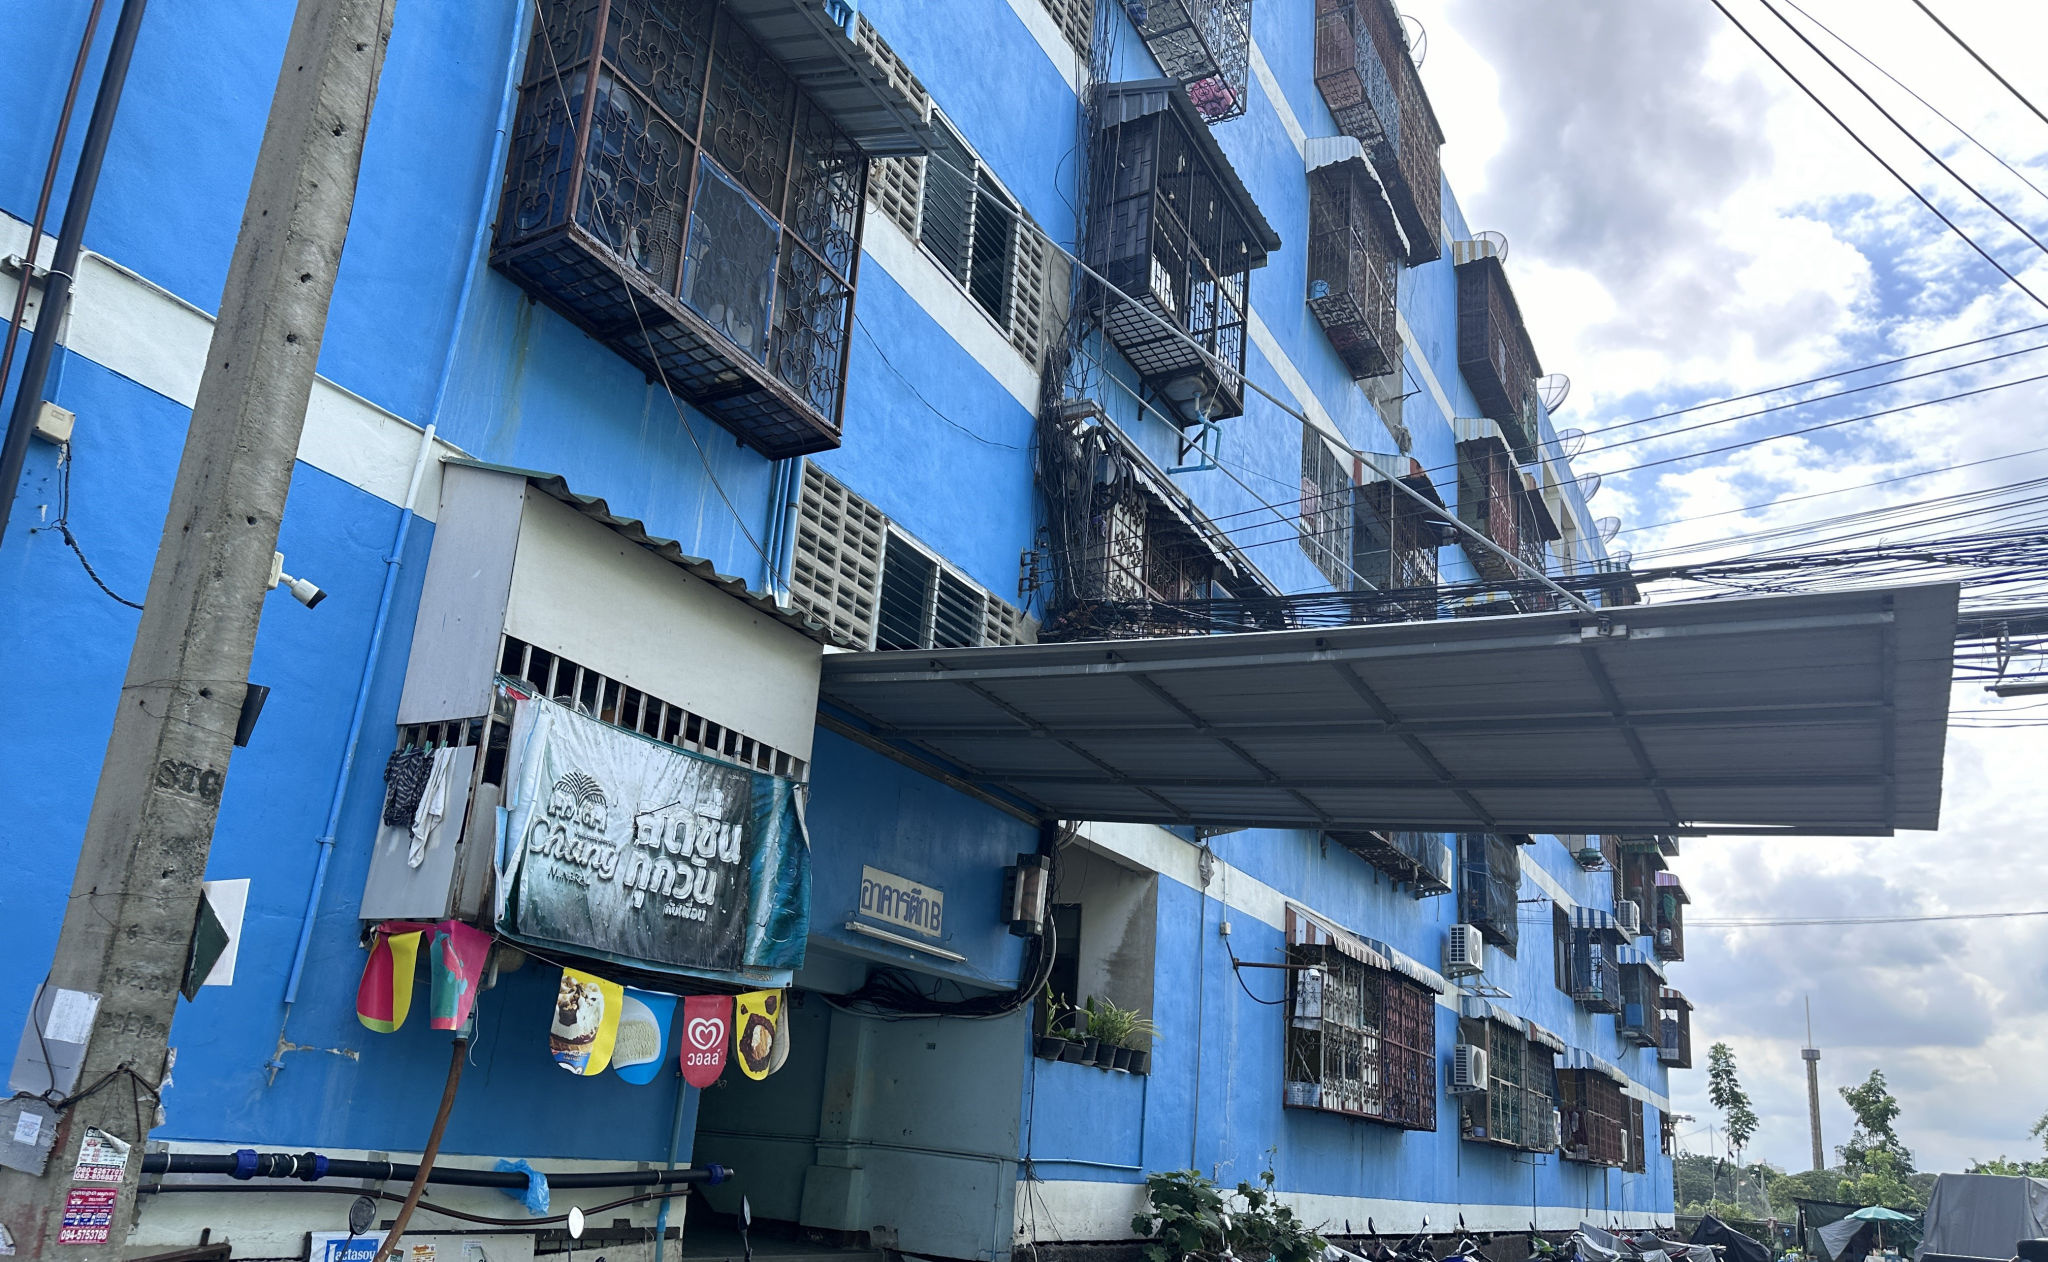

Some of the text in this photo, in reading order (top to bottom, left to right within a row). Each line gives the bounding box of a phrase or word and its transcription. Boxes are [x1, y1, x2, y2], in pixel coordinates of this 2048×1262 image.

[530, 816, 622, 881] Chang
[633, 788, 742, 865] สดชื่น
[623, 850, 717, 909] ทุกวัน
[861, 878, 941, 931] อาคารตึก B
[663, 899, 707, 922] กับเพื่อน
[687, 1048, 721, 1066] วอลล์
